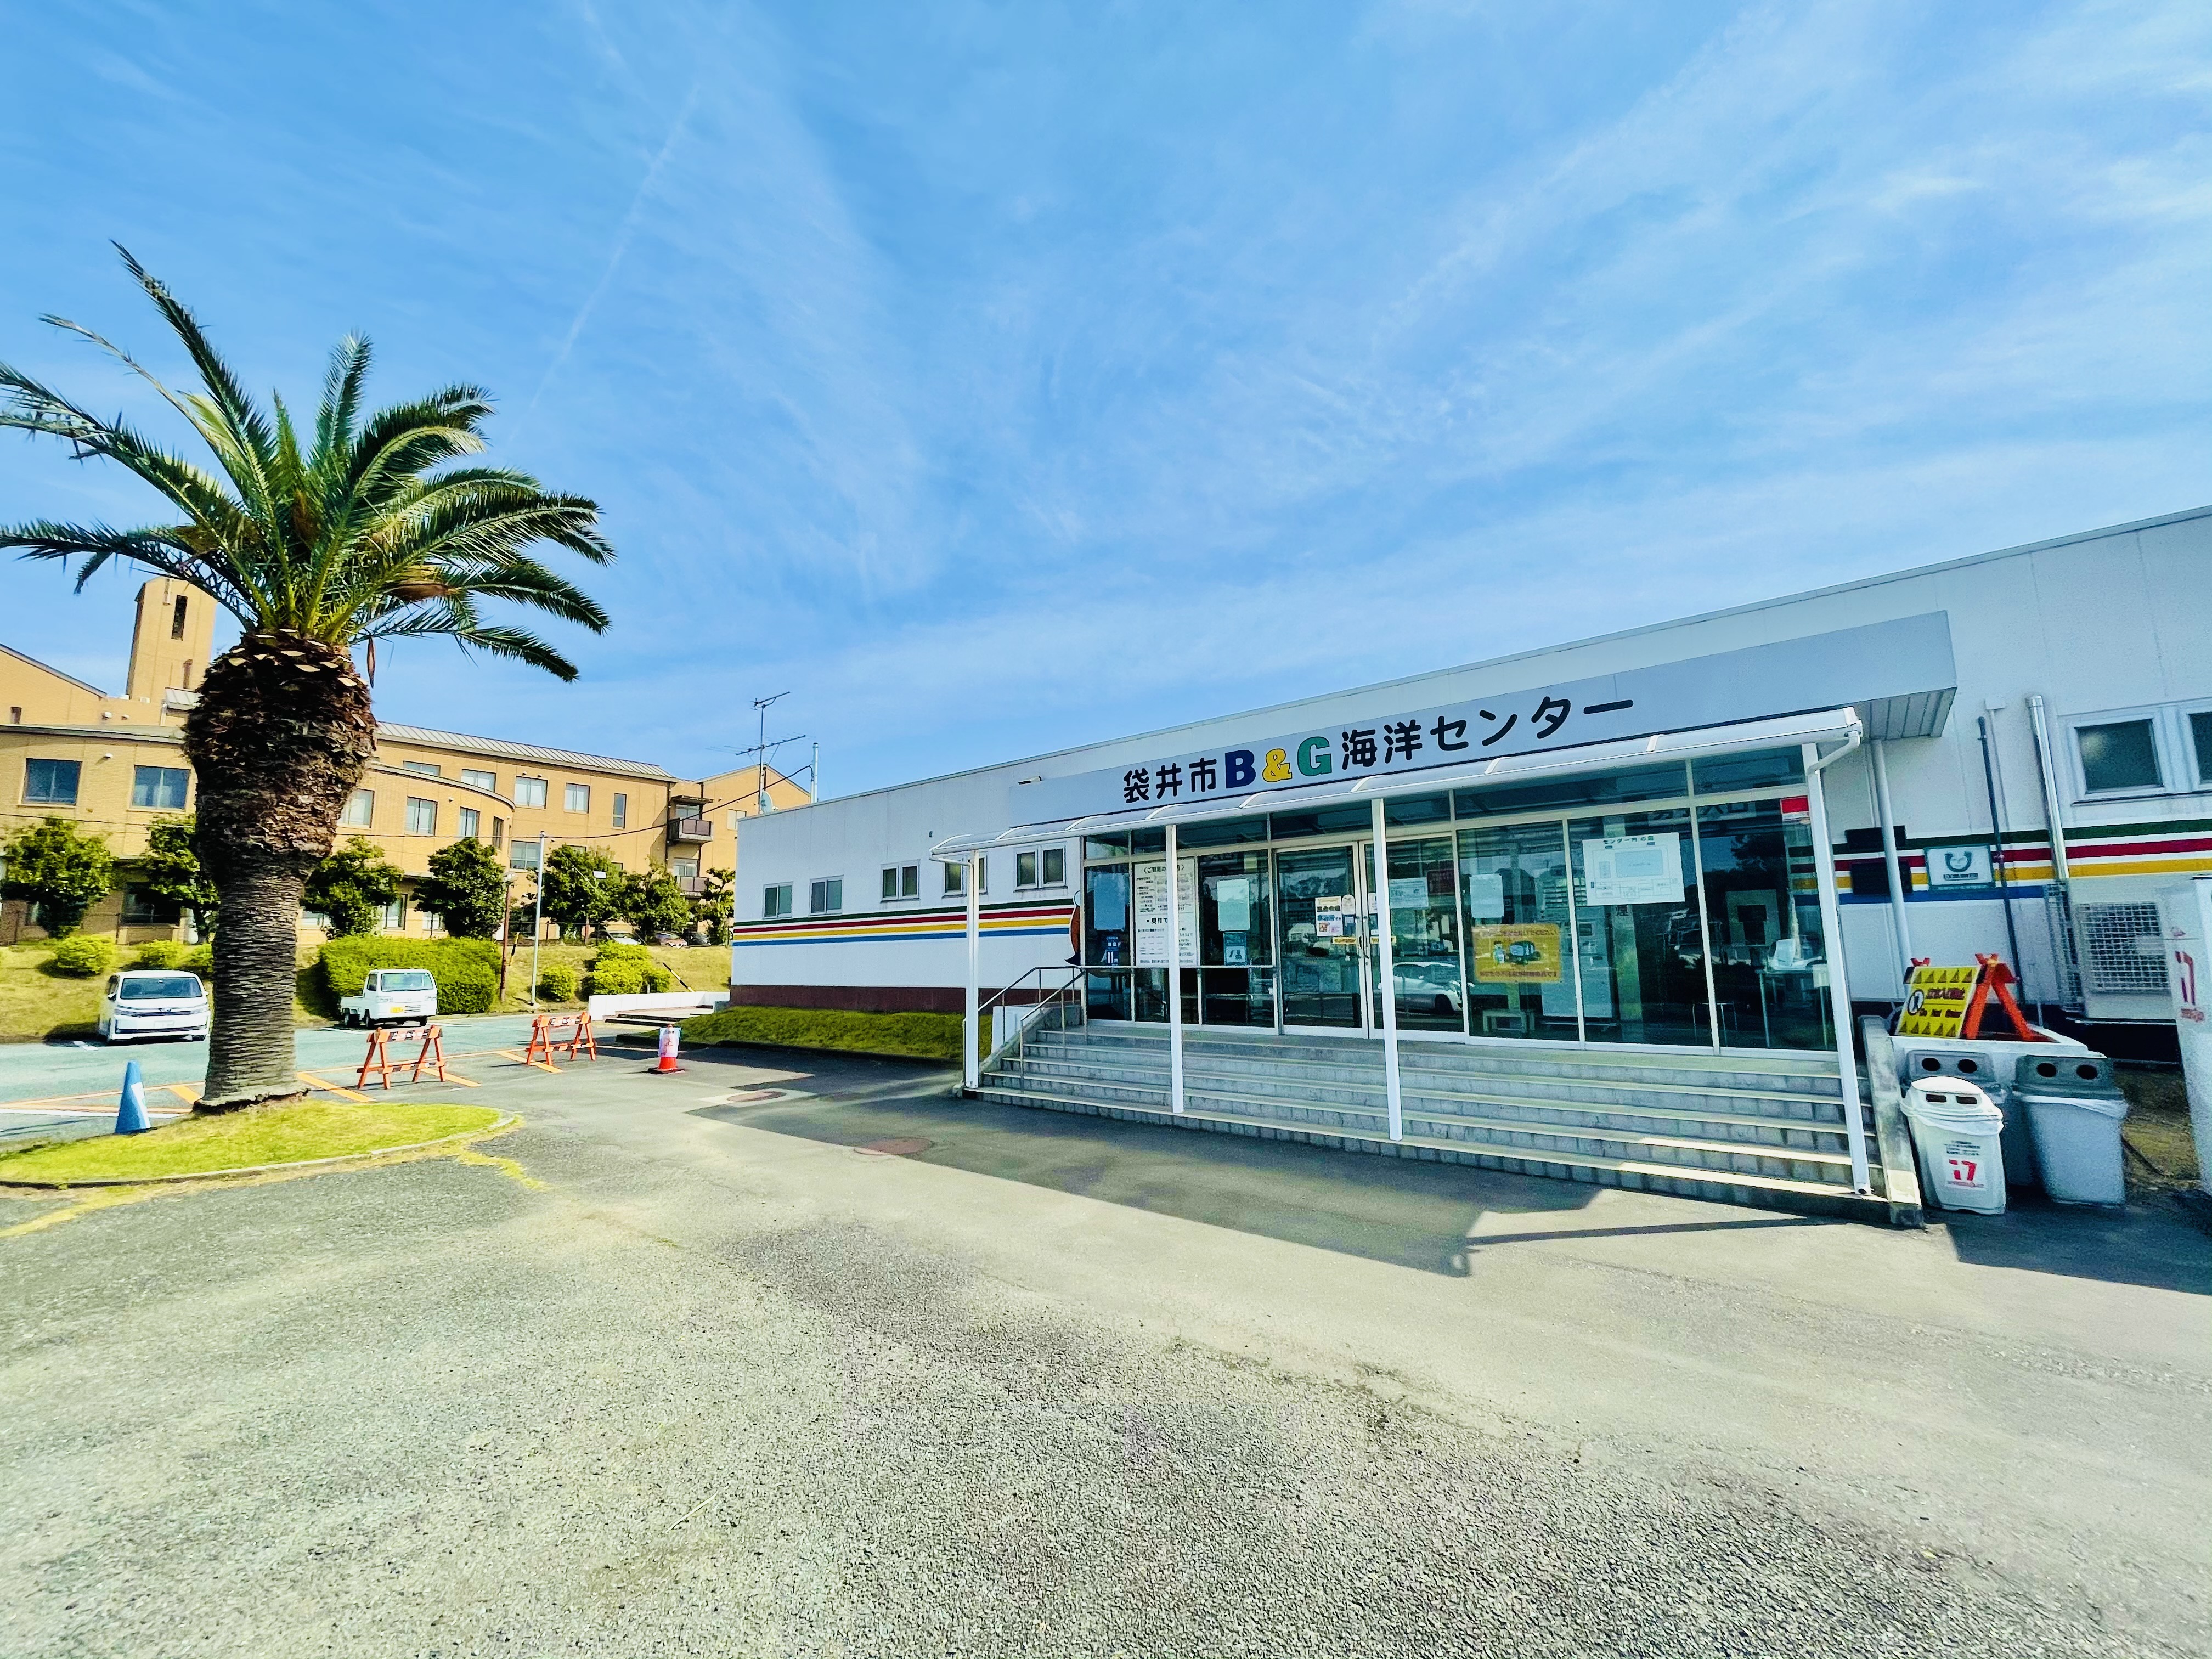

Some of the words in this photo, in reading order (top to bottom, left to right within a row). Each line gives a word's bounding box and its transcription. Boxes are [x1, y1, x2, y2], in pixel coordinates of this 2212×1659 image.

[1123, 696, 1634, 804] 袋井市B&G海洋センター
